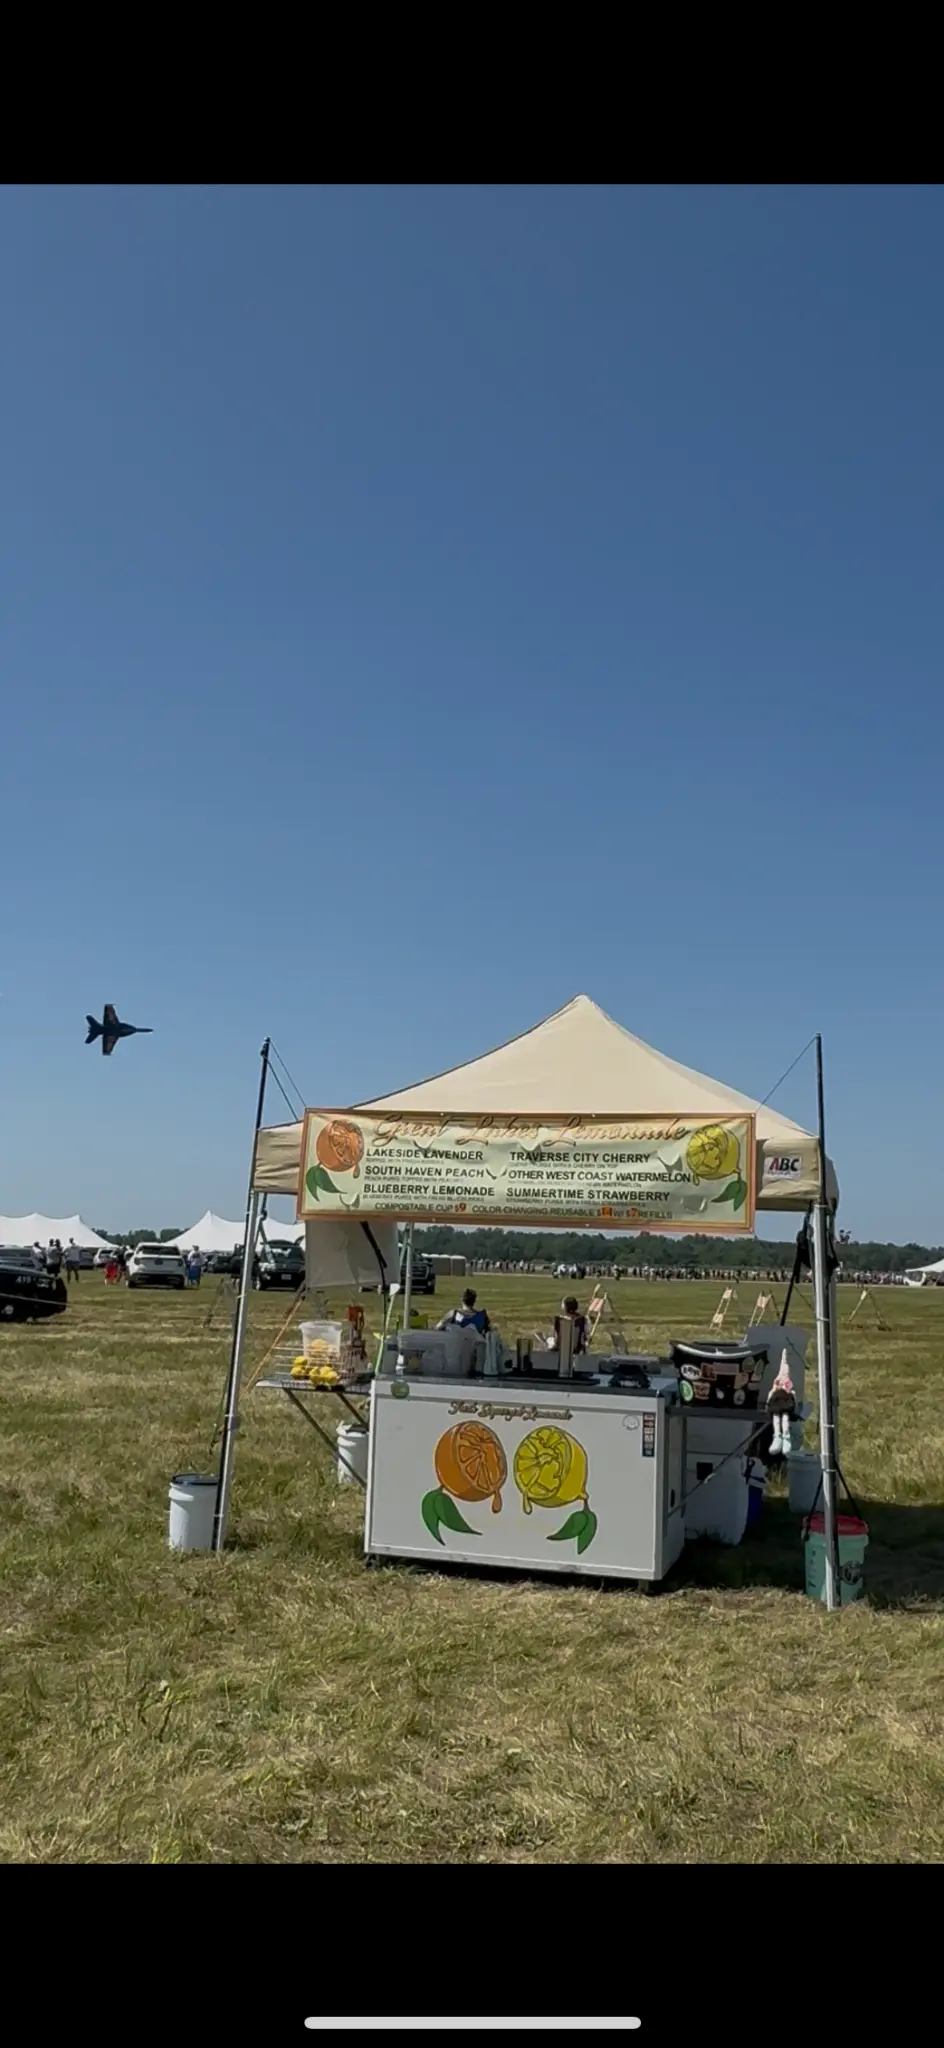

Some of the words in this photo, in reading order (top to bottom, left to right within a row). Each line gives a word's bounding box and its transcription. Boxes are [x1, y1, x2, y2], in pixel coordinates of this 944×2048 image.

[372, 1113, 465, 1147] Great
[455, 1115, 543, 1146] Lakes
[542, 1116, 691, 1147] Lemonade
[366, 1149, 420, 1158] LAKESIDE
[423, 1151, 483, 1161] LAVENDER
[509, 1152, 570, 1162] TRAVERSE
[573, 1152, 599, 1162] CITY
[602, 1153, 650, 1163] CHERRY
[769, 1157, 799, 1172] ABC
[365, 1165, 401, 1175] SOUTH
[405, 1167, 442, 1176] HAVEN
[446, 1168, 484, 1178] PEACH
[508, 1170, 544, 1179] OTHER
[546, 1171, 576, 1180] WEST
[577, 1171, 613, 1180] COAST
[616, 1172, 690, 1182] WATERMELON
[363, 1183, 429, 1194] BLUEBERRY
[432, 1185, 495, 1196] LEMONADE
[506, 1187, 584, 1199] SUMMERTIME
[587, 1189, 670, 1201] STRAWBERRY
[375, 1203, 434, 1211] COMPOSTABLE
[436, 1204, 453, 1212] CUP
